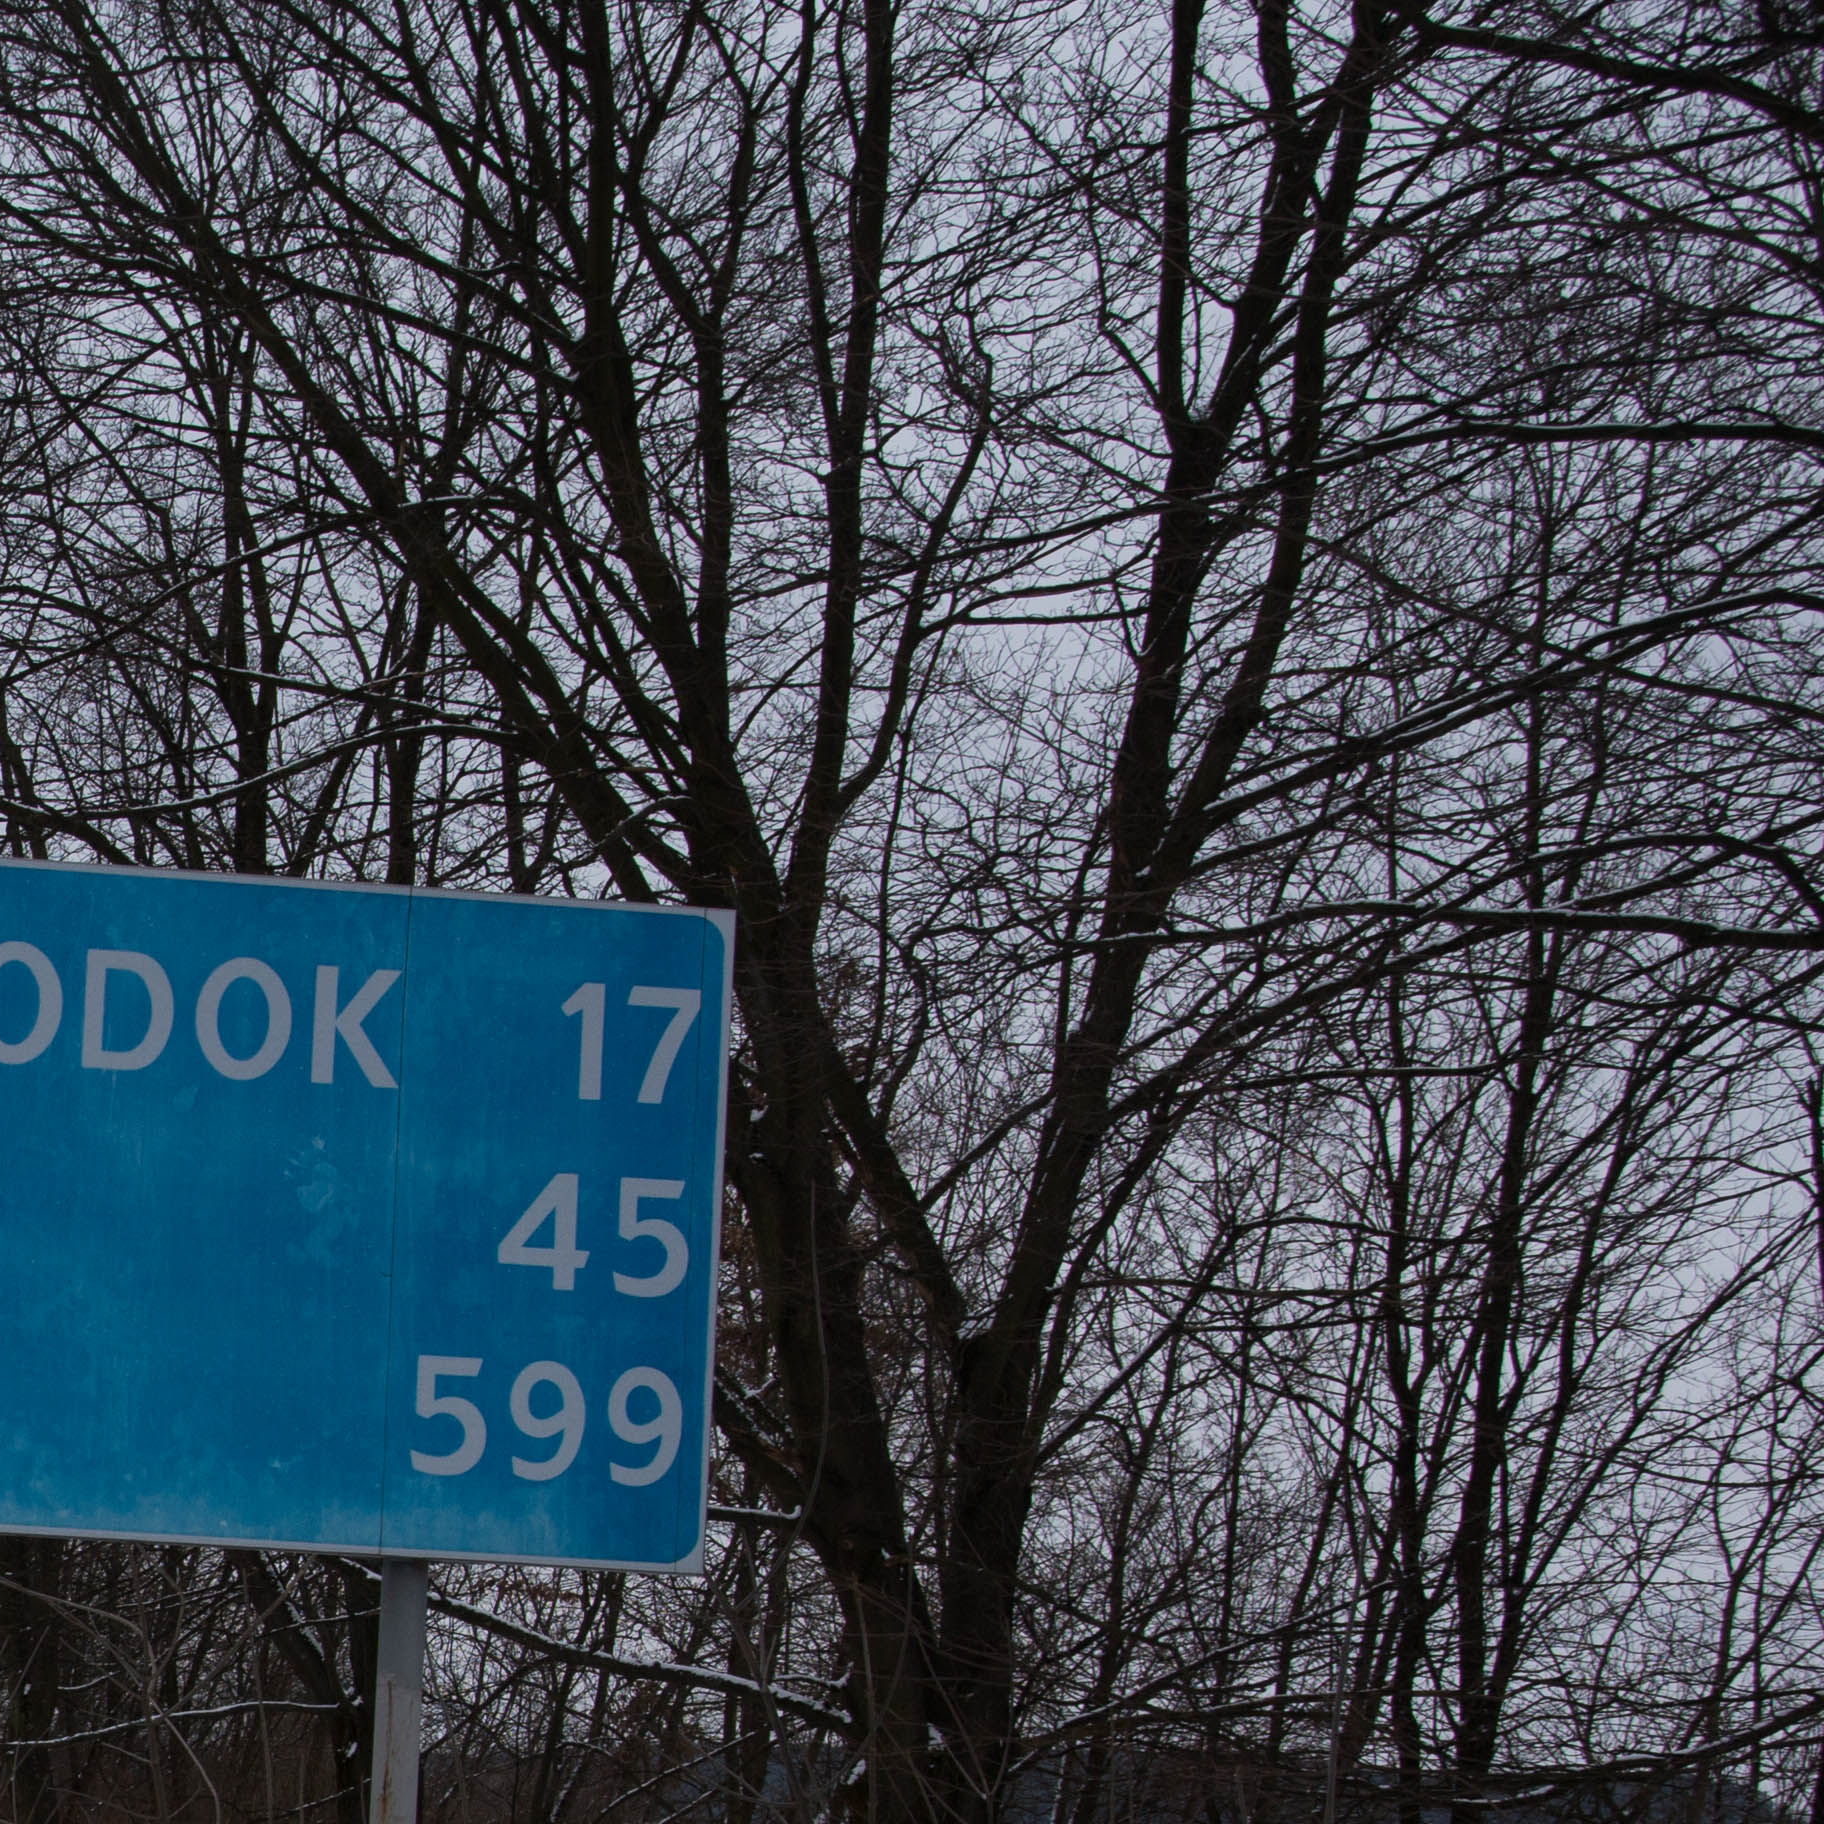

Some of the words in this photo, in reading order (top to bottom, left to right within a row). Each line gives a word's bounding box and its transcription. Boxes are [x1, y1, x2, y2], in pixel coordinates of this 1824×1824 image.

[560, 982, 702, 1104] 17
[496, 1173, 689, 1298] 45
[410, 1355, 684, 1488] 599
